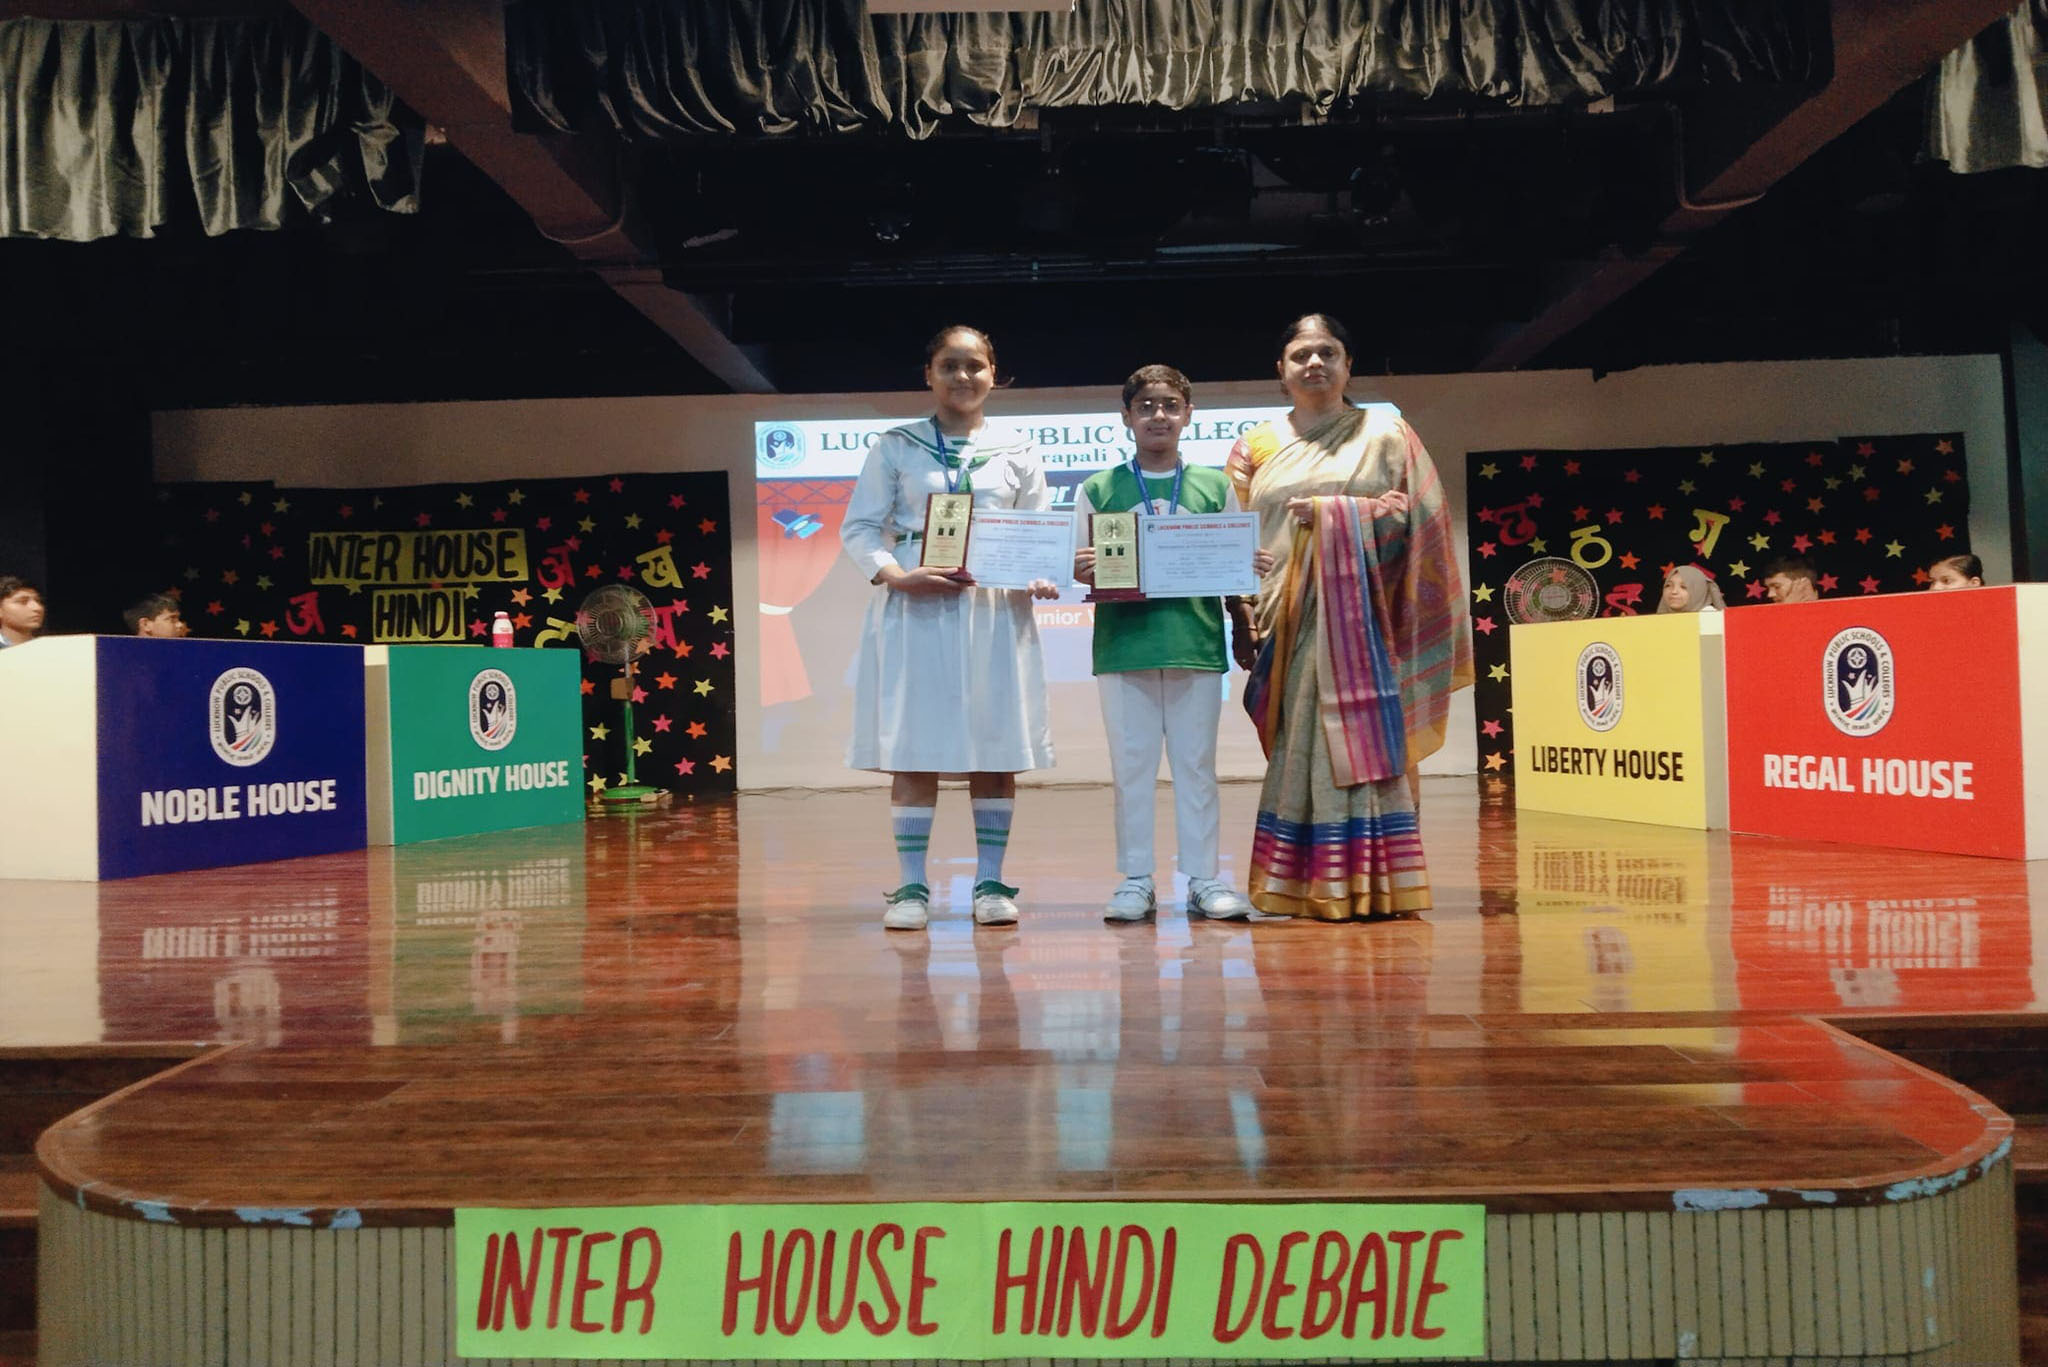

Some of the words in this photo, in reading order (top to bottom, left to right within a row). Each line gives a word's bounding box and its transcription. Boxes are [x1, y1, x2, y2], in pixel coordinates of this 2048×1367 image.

[1041, 447, 1107, 467] rapali
[1570, 525, 1612, 568] ठ
[1689, 508, 1730, 559] ग
[311, 534, 401, 581] INTER
[413, 531, 519, 580] HOUSE
[635, 545, 684, 588] ख
[376, 590, 461, 638] HINDI
[1829, 633, 1850, 657] PUBLIC
[1851, 631, 1884, 650] SCHOOLS
[1826, 660, 1834, 698] LUCKNOW
[1881, 660, 1890, 698] COLLEGES
[414, 766, 500, 801] DIGNITY
[505, 760, 569, 791] HOUSE
[1532, 745, 1606, 776] LIBERTY
[1614, 749, 1684, 782] HOUSE
[1764, 753, 1855, 793] REGAL
[1862, 758, 1975, 800] HOUSE
[141, 785, 240, 827] NOBLE
[248, 779, 337, 818] HOUSE
[477, 1226, 663, 1334] INTER
[721, 1222, 947, 1337] HOUSE
[992, 1224, 1177, 1339] HINDI
[1213, 1229, 1465, 1344] DEBATE
